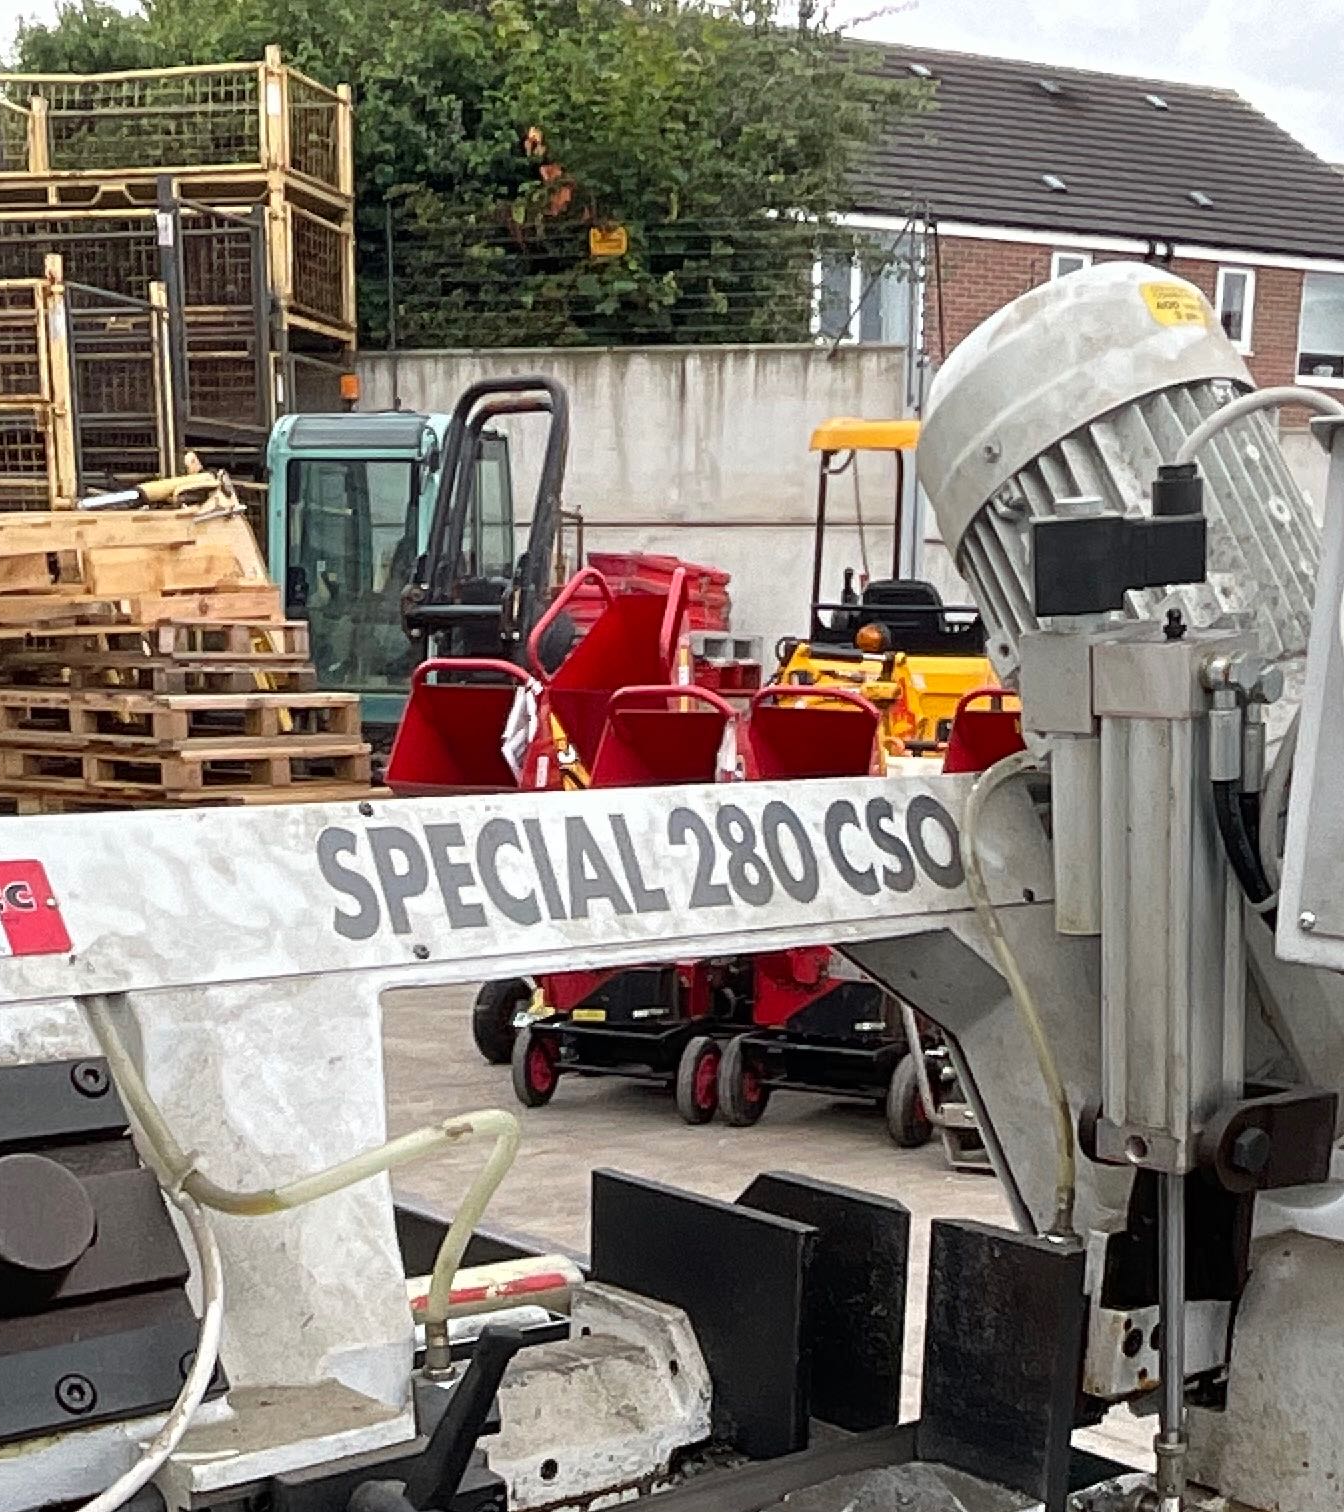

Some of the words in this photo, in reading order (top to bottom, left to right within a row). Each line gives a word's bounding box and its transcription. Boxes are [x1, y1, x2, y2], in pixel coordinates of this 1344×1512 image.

[317, 812, 668, 940] SPECIAL
[668, 800, 819, 909] 280
[824, 793, 968, 896] CSO
